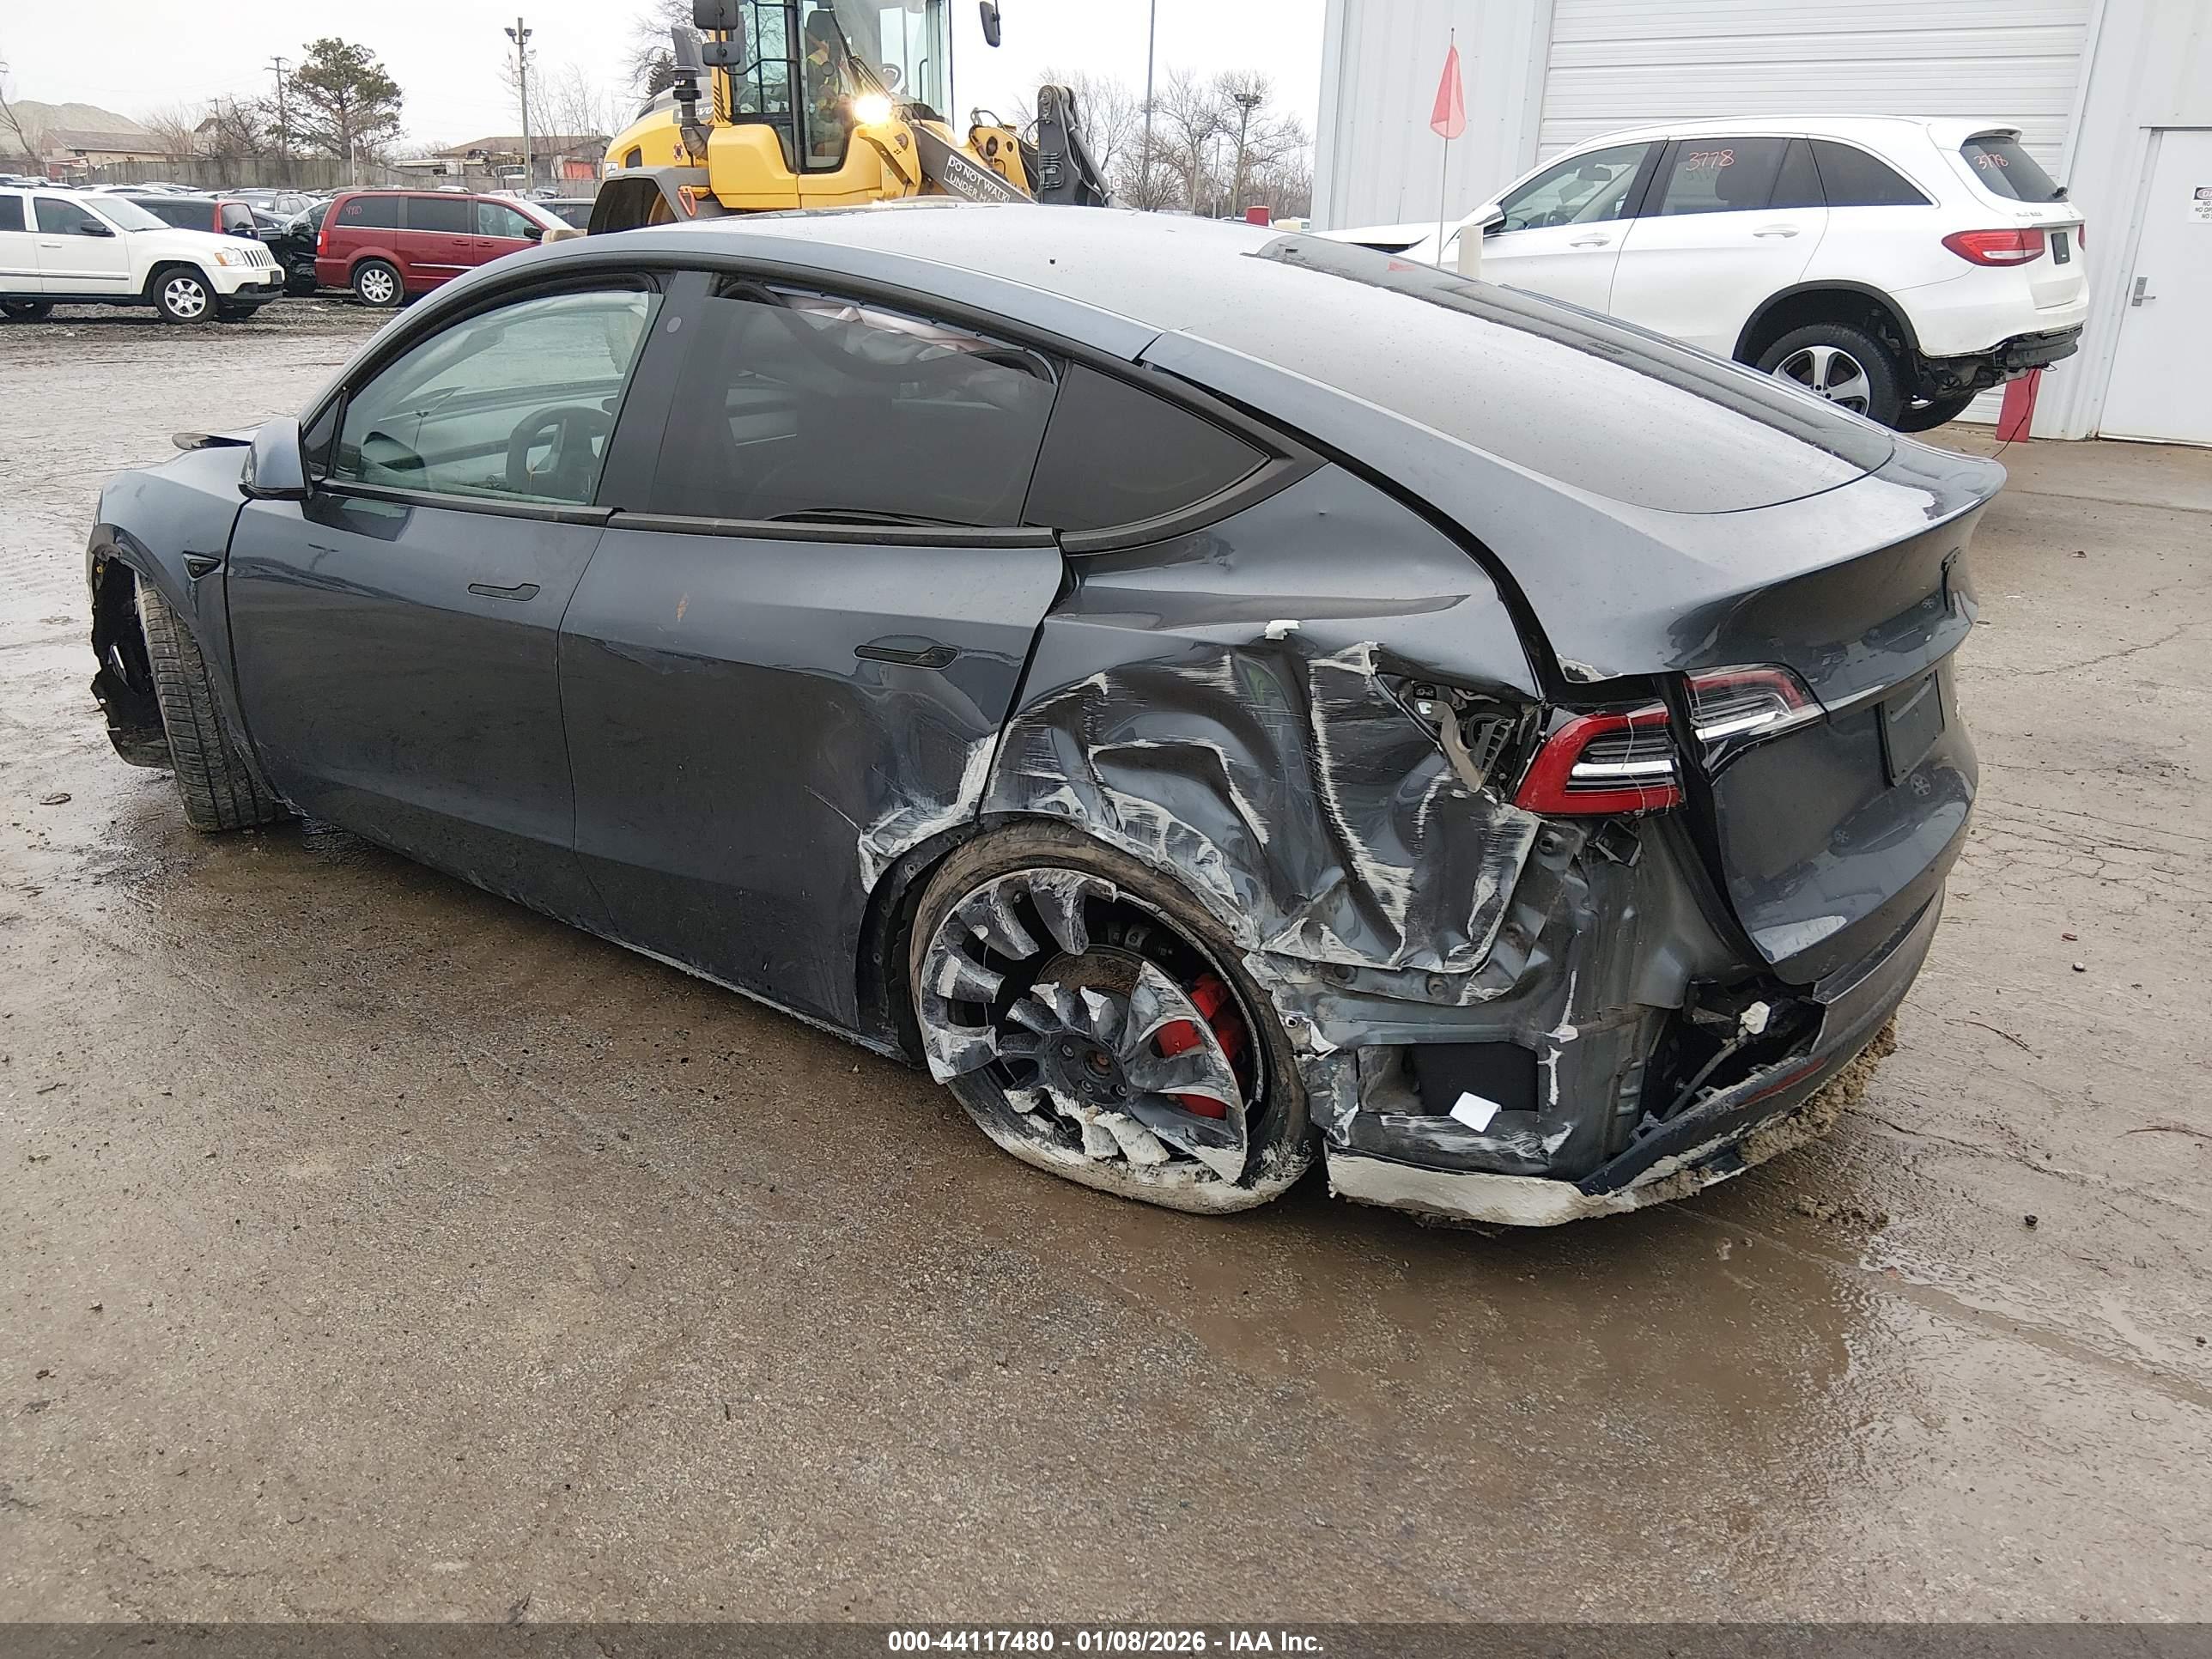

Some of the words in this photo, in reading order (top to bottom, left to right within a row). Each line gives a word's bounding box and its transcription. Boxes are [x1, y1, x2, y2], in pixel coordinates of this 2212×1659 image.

[1686, 149, 1735, 171] 3778
[1973, 154, 2008, 170] 3778
[948, 158, 962, 172] DO
[963, 167, 982, 185] NOT
[983, 179, 1008, 203] WALK
[950, 173, 978, 197] UNDER
